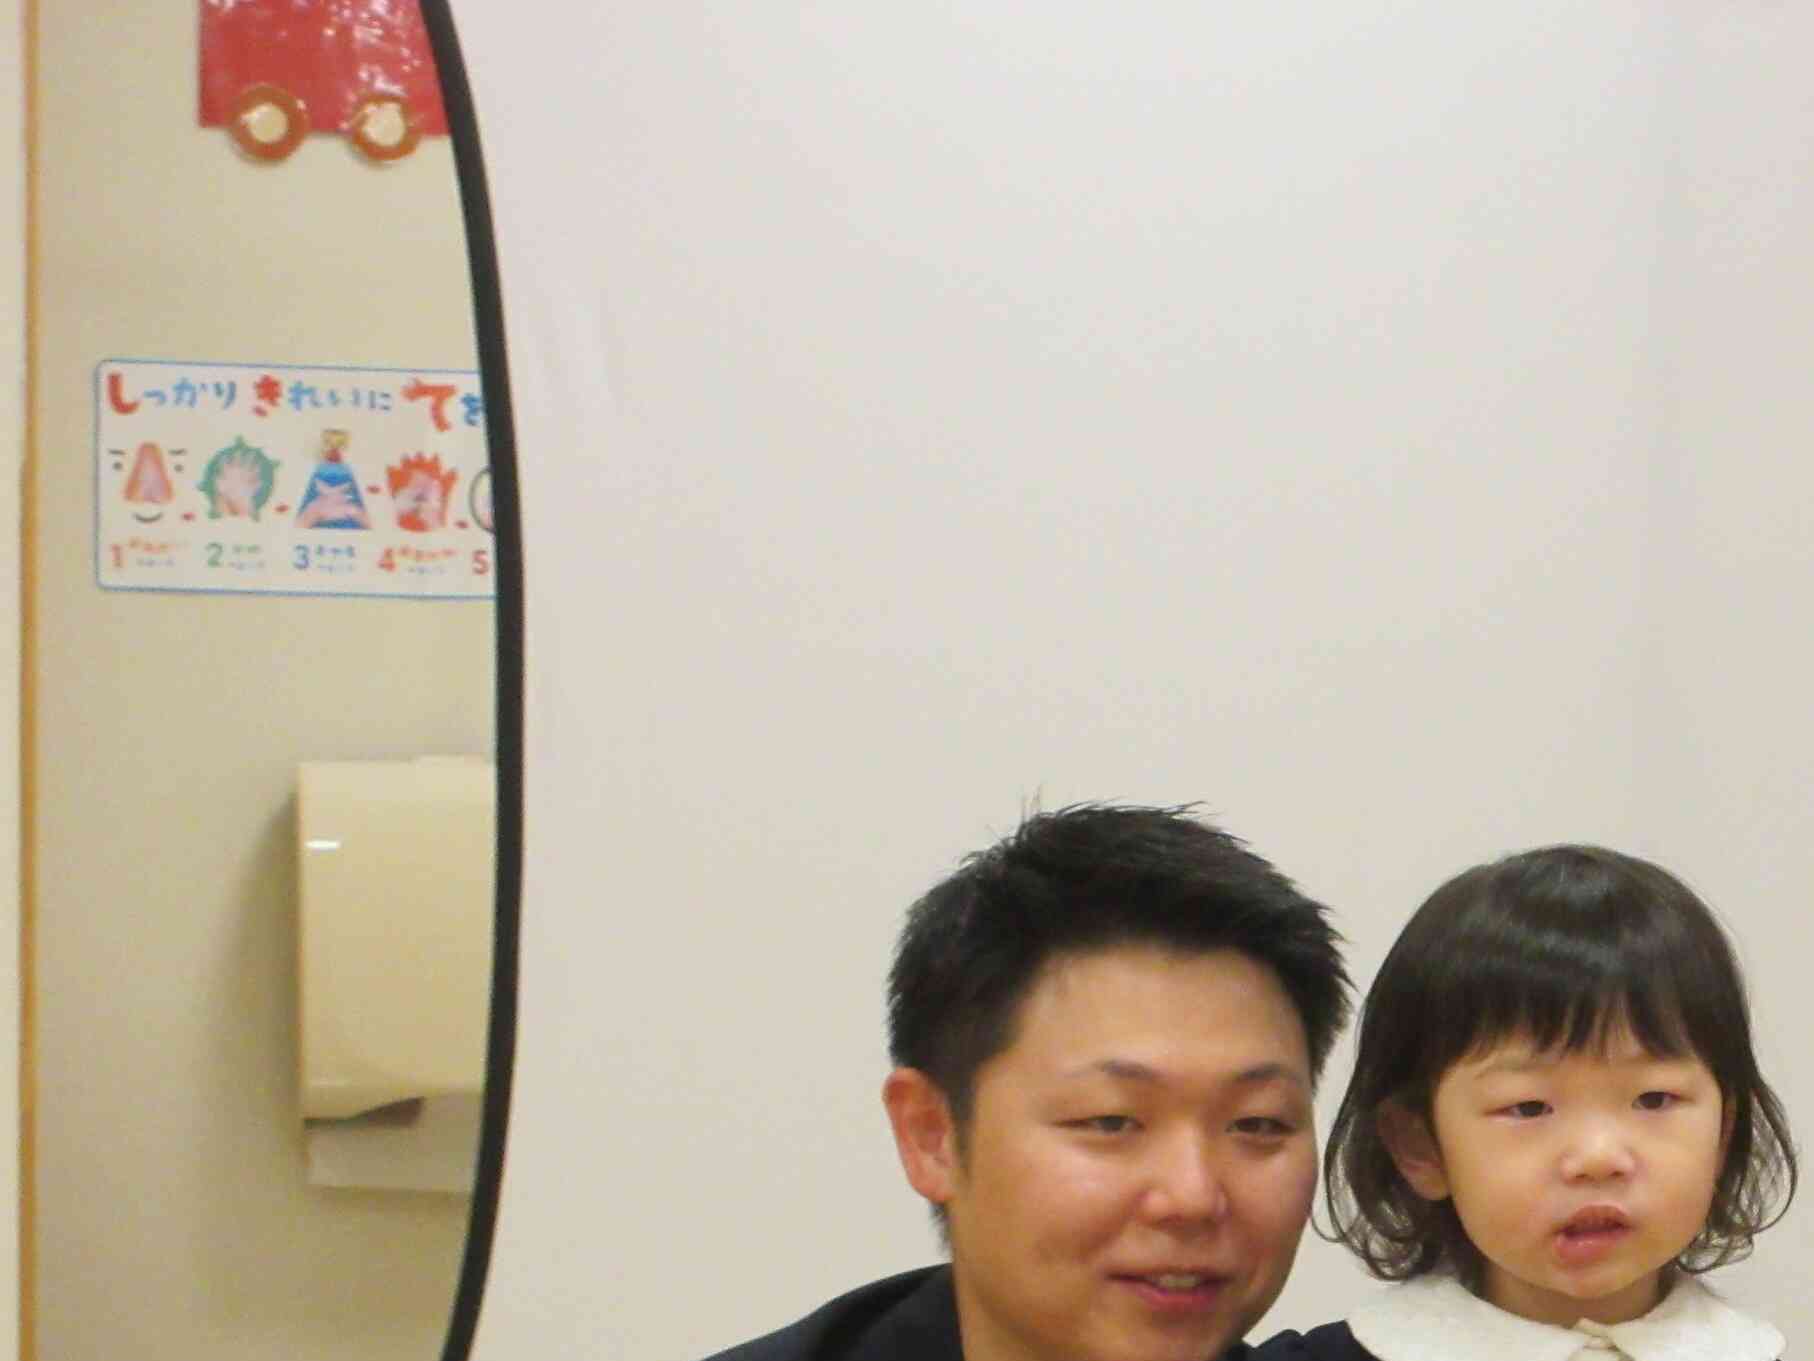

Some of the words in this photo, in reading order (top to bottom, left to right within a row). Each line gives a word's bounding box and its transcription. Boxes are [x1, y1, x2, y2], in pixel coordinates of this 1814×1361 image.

[205, 541, 223, 567] 2
[293, 544, 310, 570] 3
[377, 547, 396, 572] 4
[472, 549, 489, 575] 5
